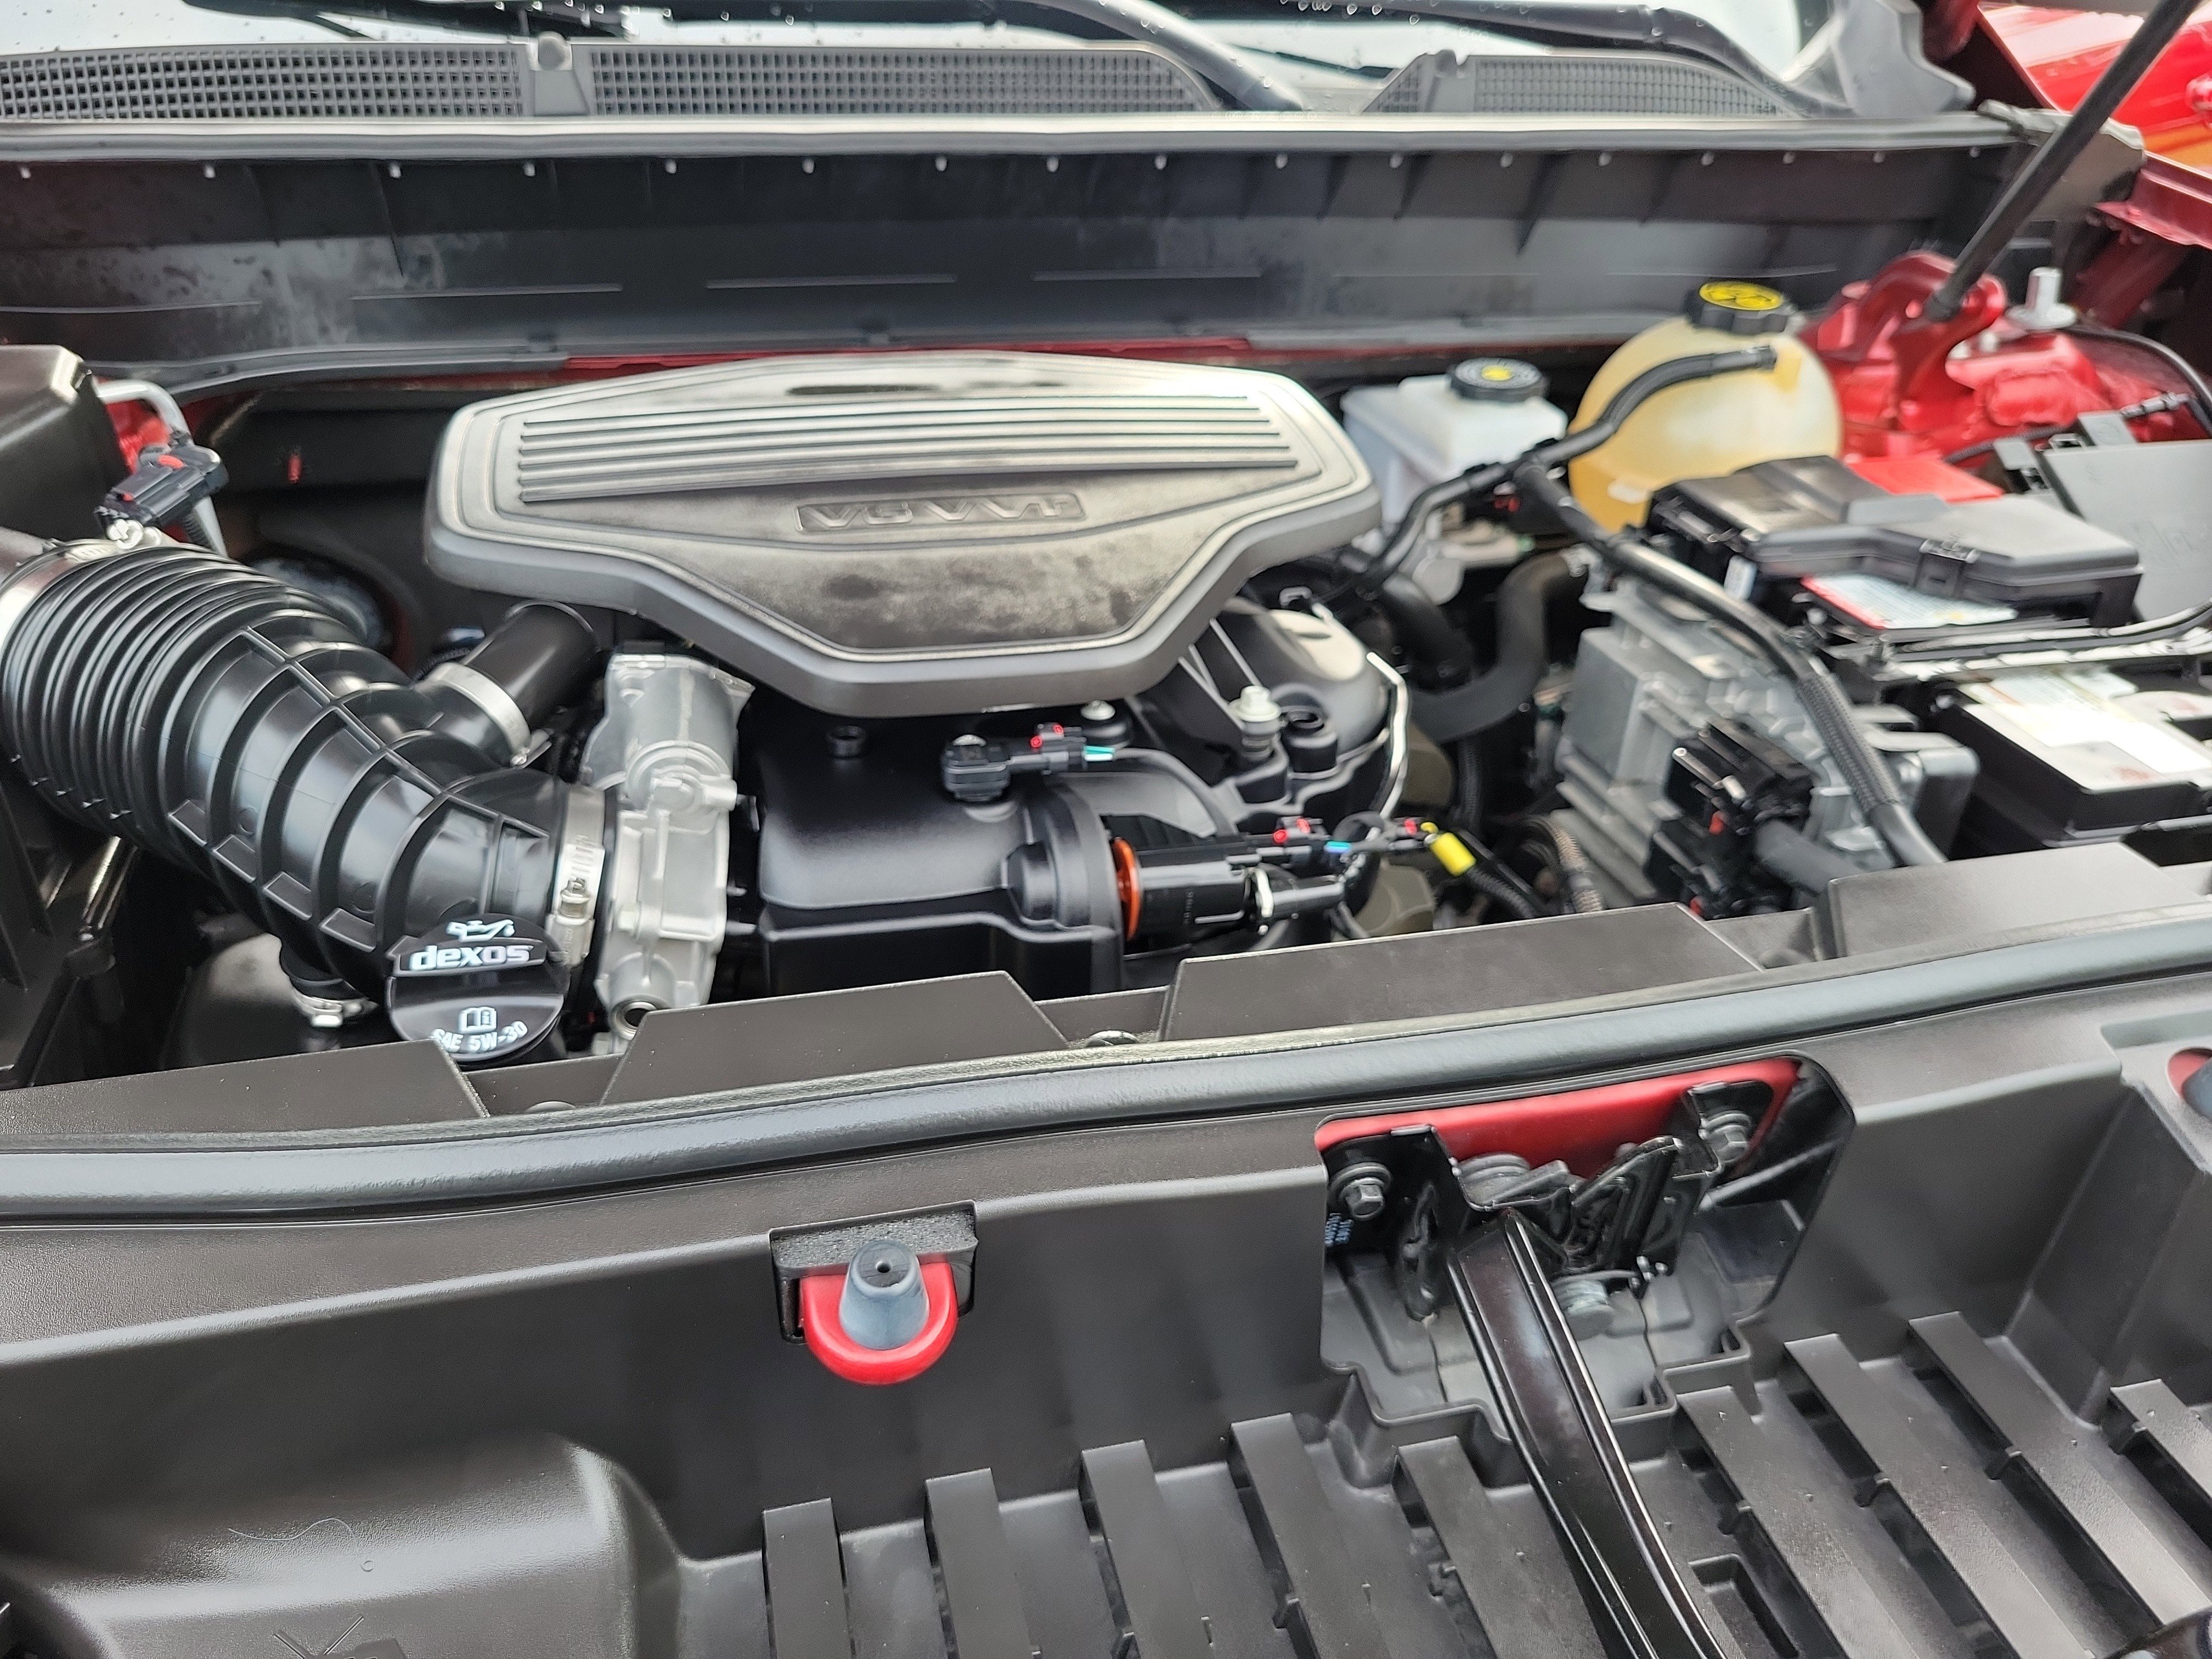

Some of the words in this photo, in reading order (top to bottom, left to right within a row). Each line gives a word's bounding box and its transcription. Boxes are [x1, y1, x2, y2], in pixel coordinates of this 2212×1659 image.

[409, 945, 534, 971] dexos
[431, 1029, 464, 1053] SAE
[466, 1021, 528, 1053] 5W-30
